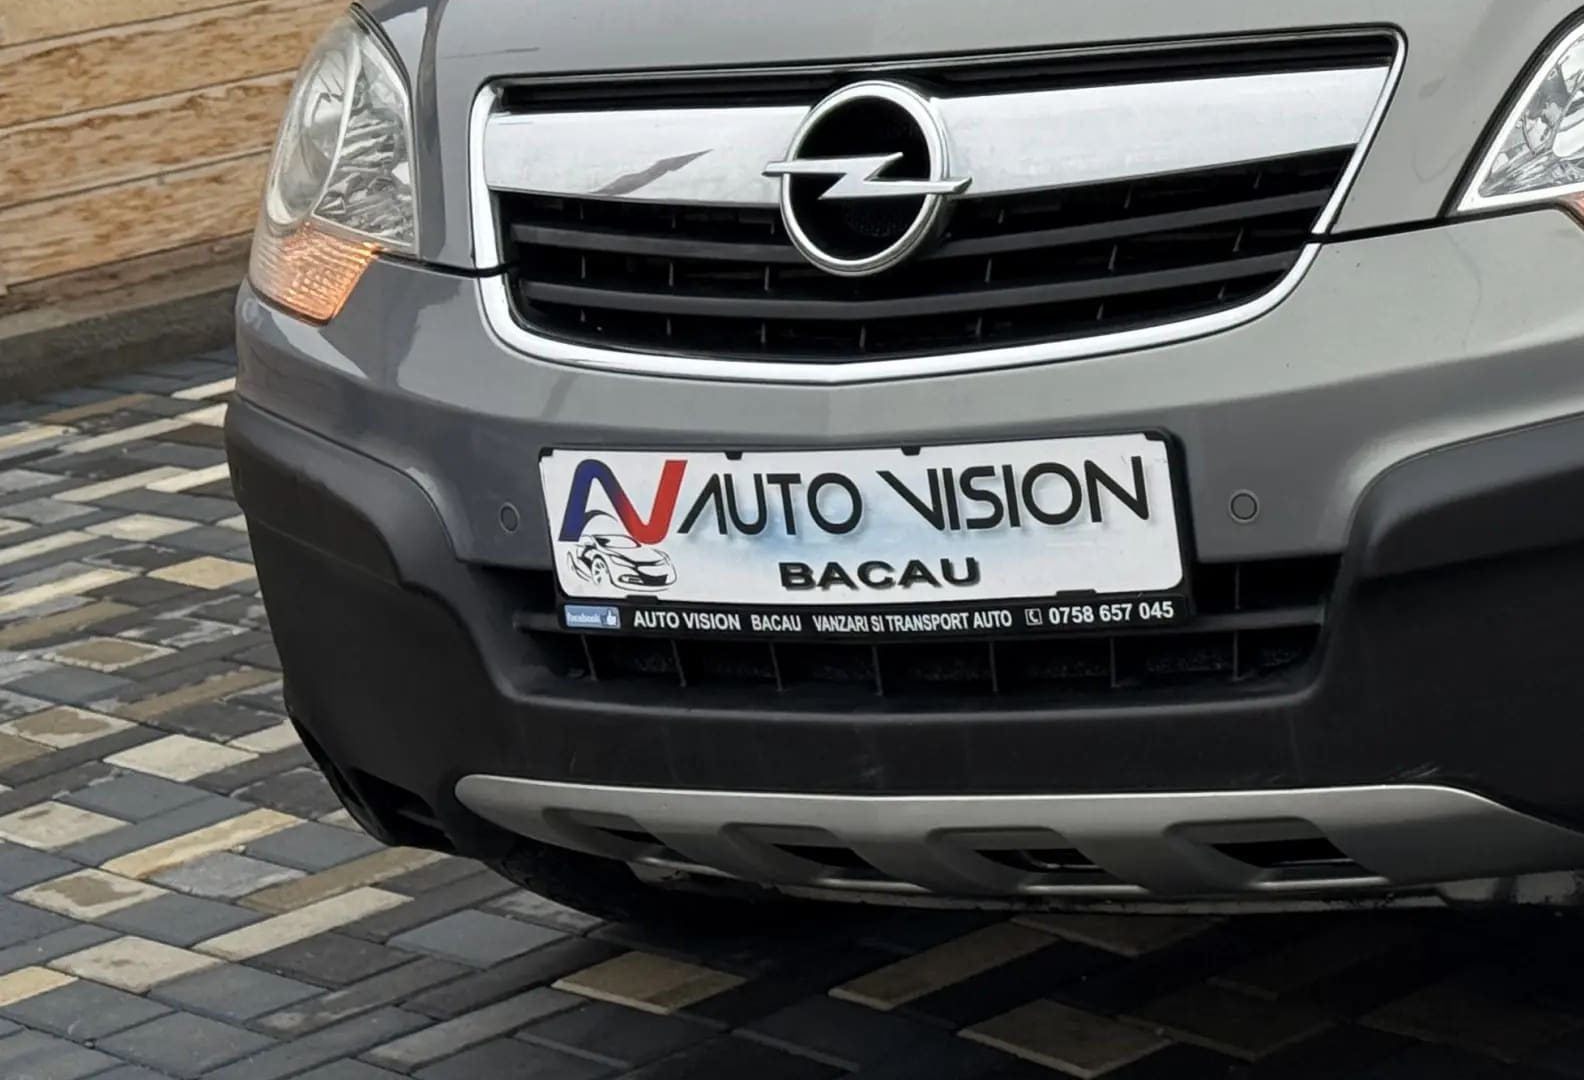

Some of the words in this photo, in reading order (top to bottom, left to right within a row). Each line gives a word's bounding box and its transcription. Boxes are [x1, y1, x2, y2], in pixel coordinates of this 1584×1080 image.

[677, 472, 863, 536] AUTO
[876, 456, 1149, 531] VISION
[778, 556, 981, 591] BACAU
[634, 610, 681, 629] AUTO
[682, 611, 741, 631] VISION
[751, 614, 801, 632] BACAU
[812, 614, 869, 633] VANZARI
[871, 614, 884, 632] SI
[885, 611, 969, 632] TRANSPORT
[973, 609, 1013, 629] AUTO
[1048, 605, 1095, 625] 0758
[1099, 603, 1133, 622] 657
[1139, 600, 1175, 620] 045
